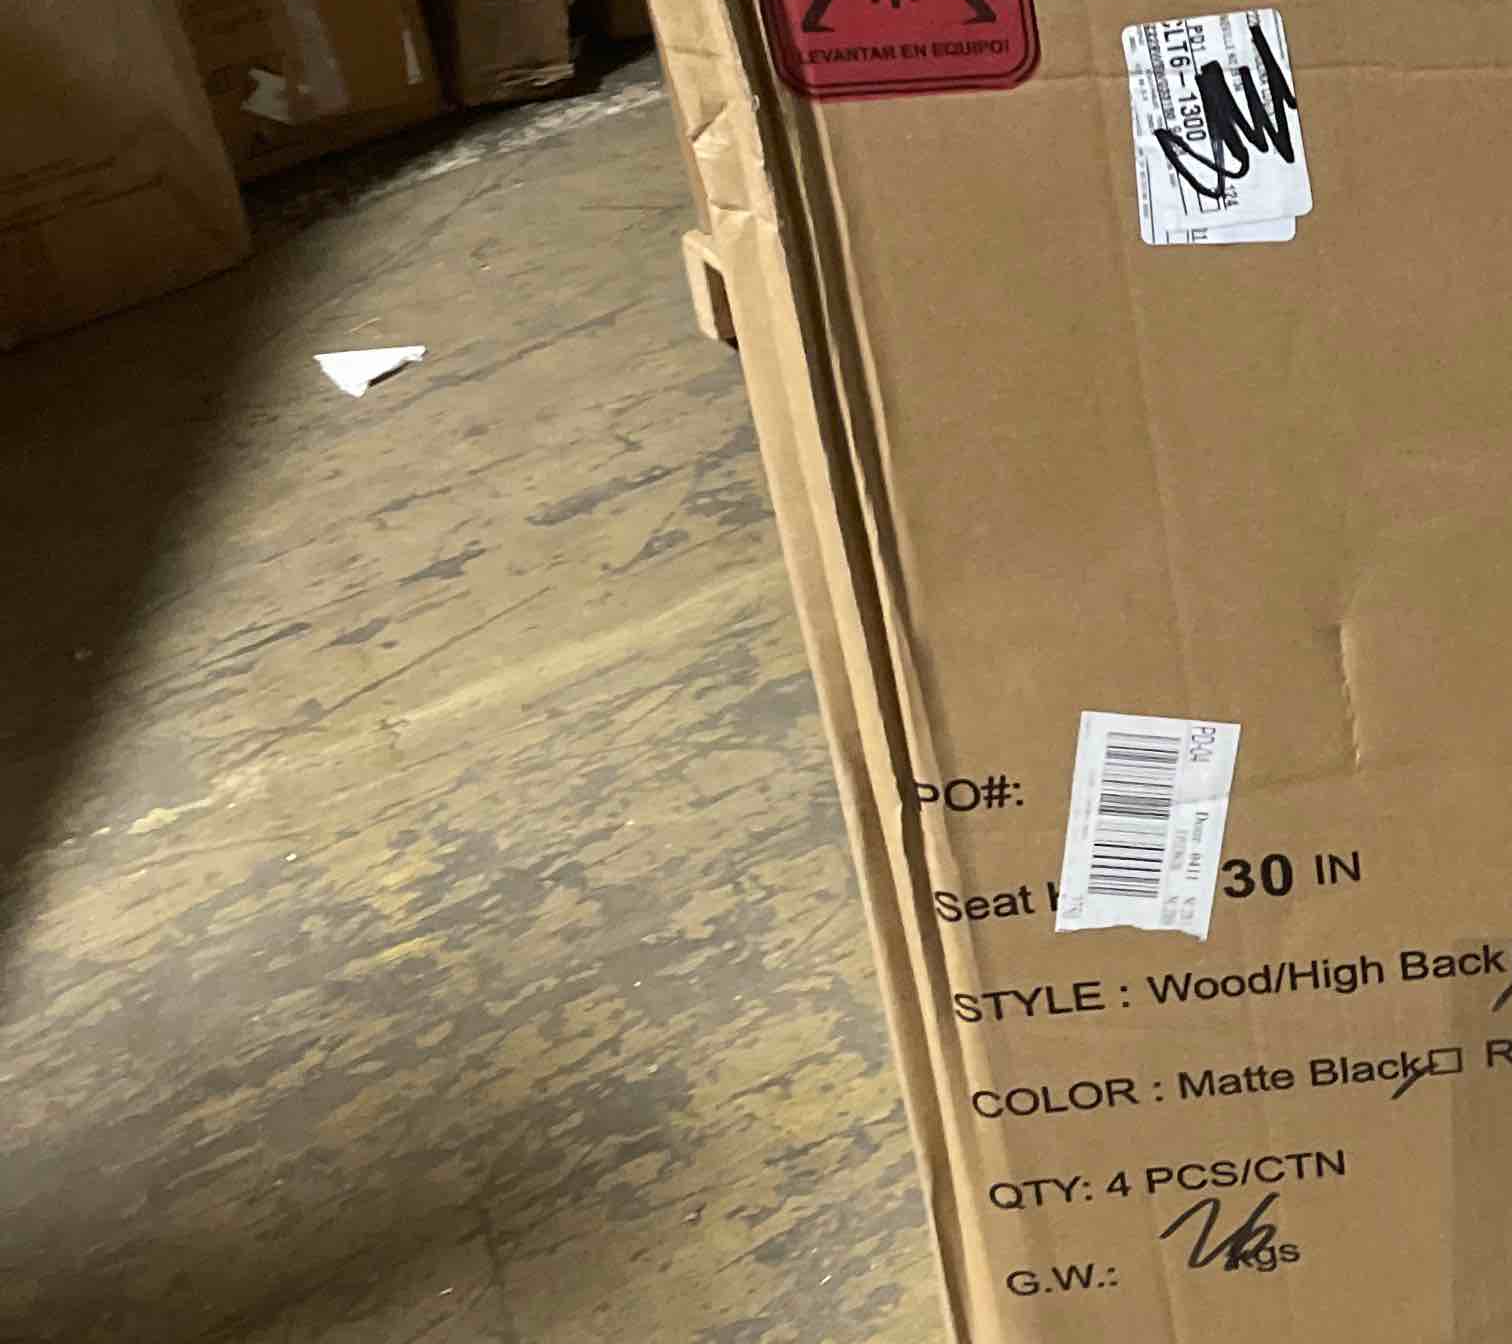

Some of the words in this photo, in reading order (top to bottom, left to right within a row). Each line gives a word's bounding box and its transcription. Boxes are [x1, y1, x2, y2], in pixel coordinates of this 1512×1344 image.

[915, 775, 1024, 812] PO#:
[935, 884, 1036, 923] Seat
[1221, 852, 1294, 900] 30
[1314, 850, 1363, 886] IN
[953, 981, 1106, 1023] STYLE
[1147, 954, 1385, 1008] Wood/High
[1400, 943, 1506, 982] Back
[971, 1077, 1140, 1119] COLOR
[1178, 1064, 1296, 1100] Matte
[1309, 1051, 1424, 1089] Black
[988, 1175, 1094, 1210] QTY:
[1106, 1171, 1132, 1199] 4
[1145, 1149, 1347, 1196] PCS/CTN
